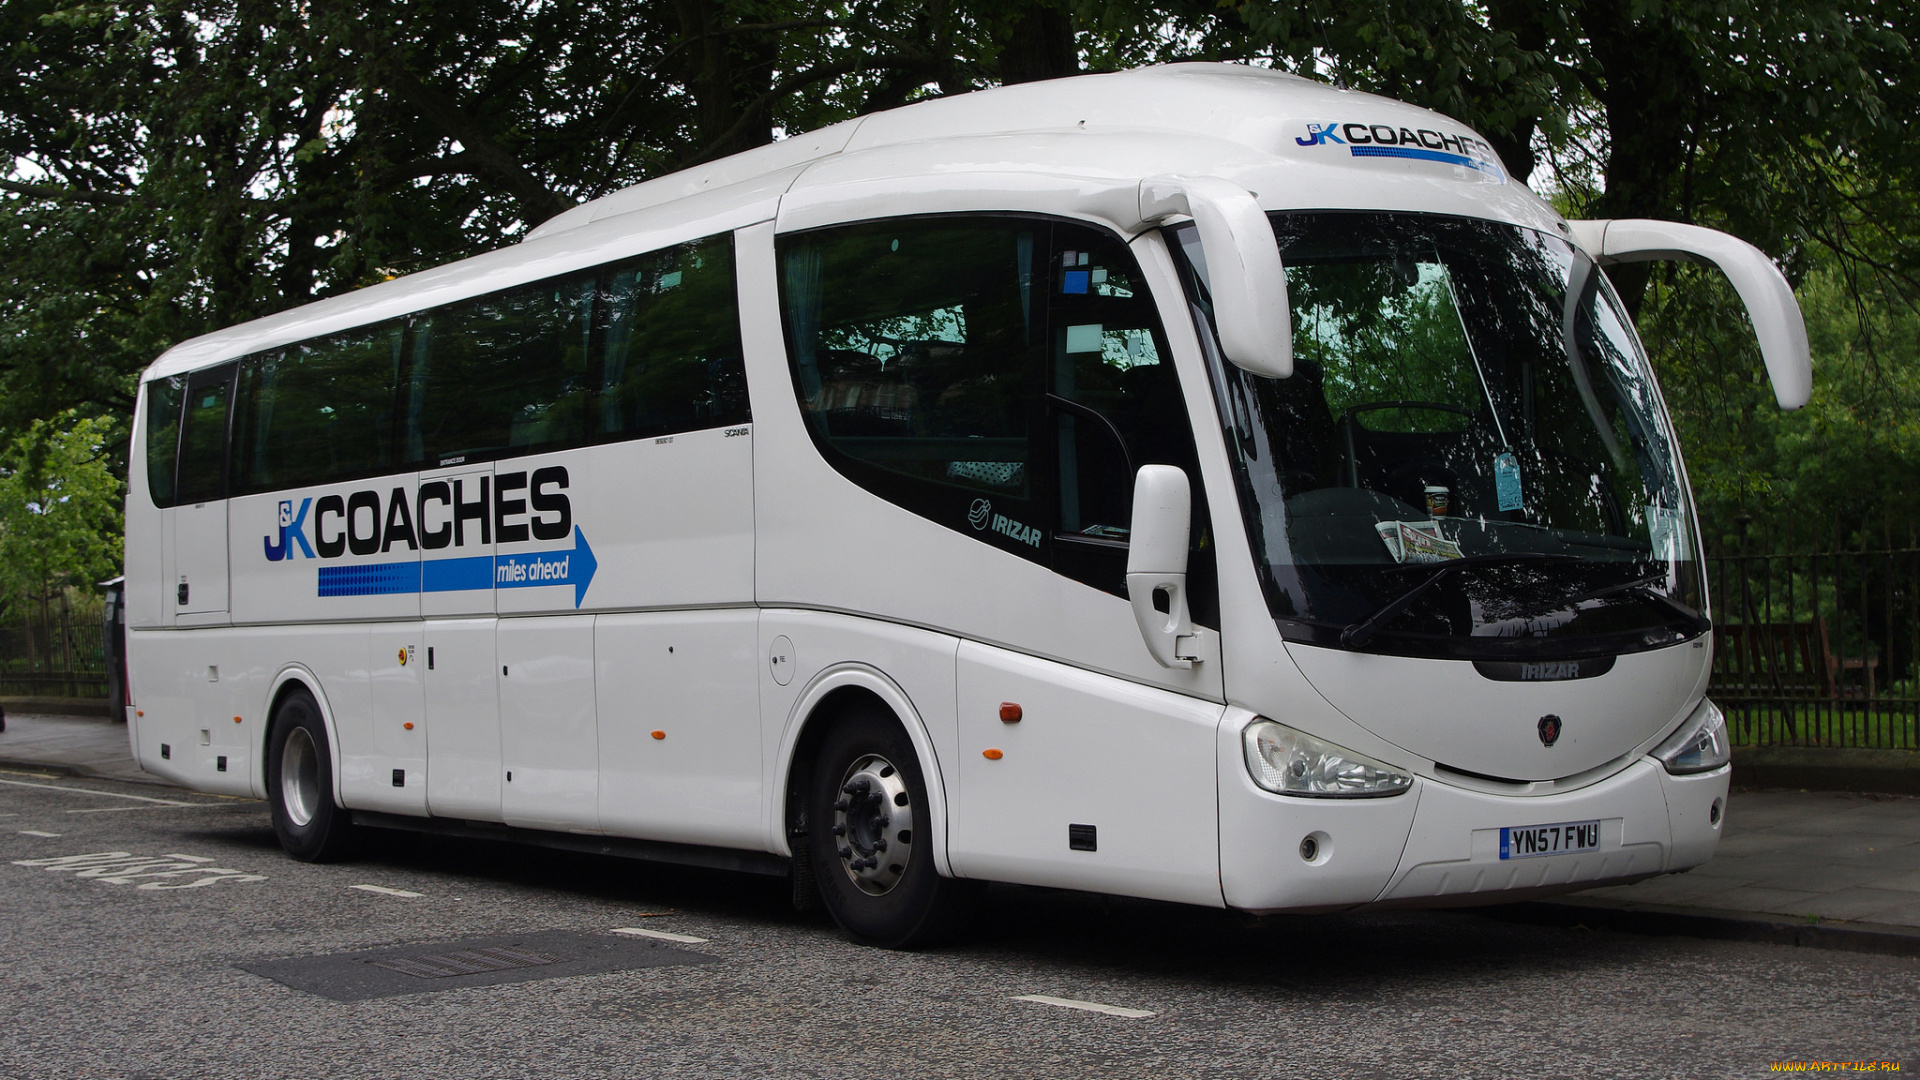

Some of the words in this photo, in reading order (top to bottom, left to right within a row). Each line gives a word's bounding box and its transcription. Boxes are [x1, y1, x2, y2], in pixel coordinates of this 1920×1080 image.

[315, 465, 572, 559] COACHES
[991, 513, 1042, 549] IRIZAR
[497, 559, 527, 582] miles
[528, 555, 569, 581] ahead
[1521, 663, 1580, 680] IRIZAR
[1513, 827, 1560, 854] YN57
[1565, 824, 1598, 850] FWU
